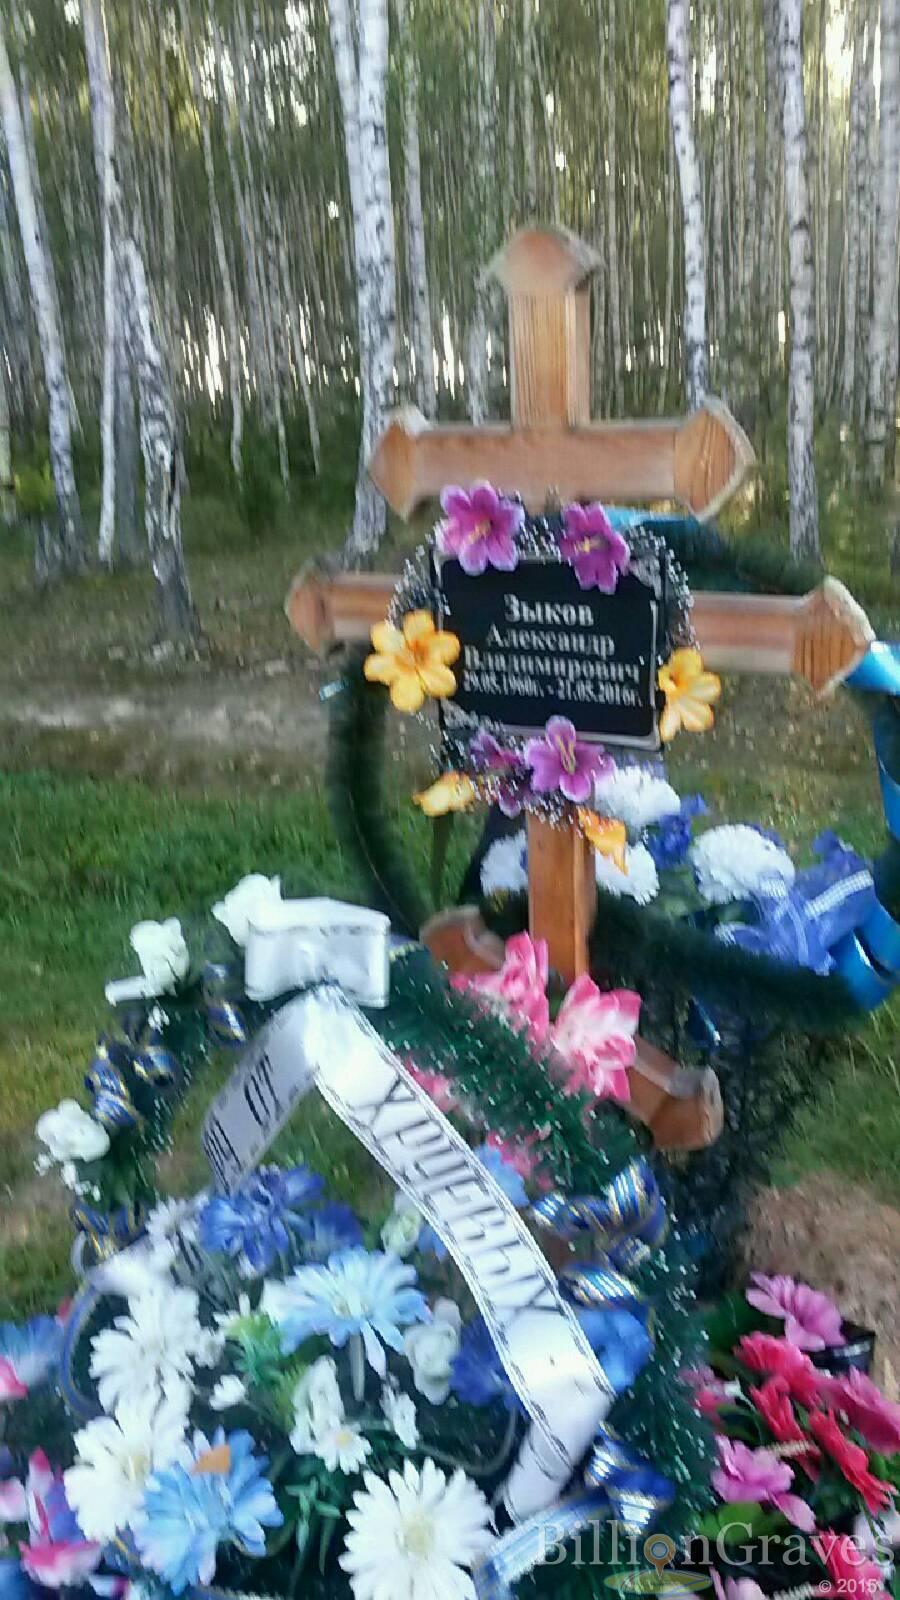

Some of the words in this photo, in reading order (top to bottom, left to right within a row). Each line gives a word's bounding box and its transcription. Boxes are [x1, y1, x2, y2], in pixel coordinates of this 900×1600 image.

[503, 593, 595, 627] Зыков
[486, 623, 615, 660] Александр
[464, 645, 640, 684] Владимирович
